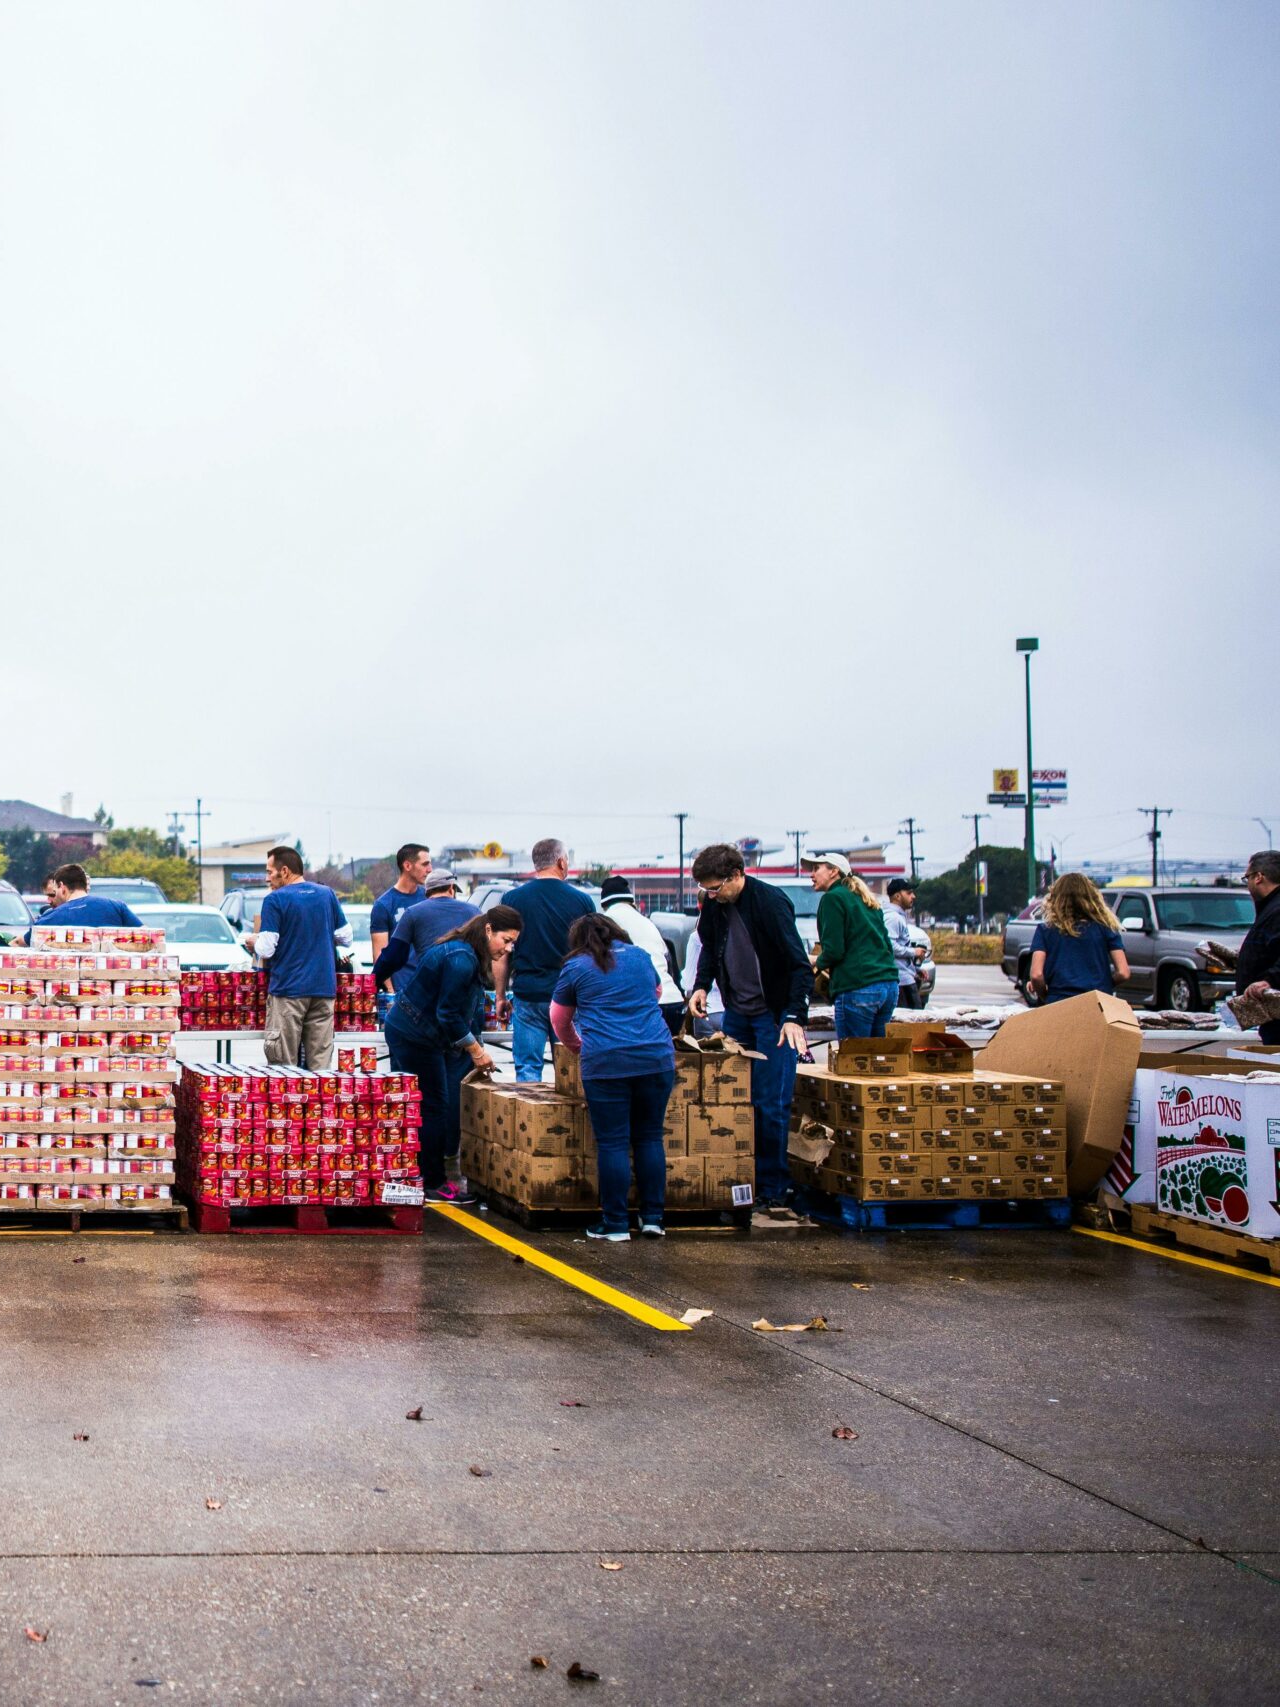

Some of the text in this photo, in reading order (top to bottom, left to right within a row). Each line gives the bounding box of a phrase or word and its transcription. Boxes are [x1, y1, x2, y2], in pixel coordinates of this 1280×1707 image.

[1032, 769, 1066, 781] EXXON
[1160, 1081, 1177, 1099] Fresh
[1158, 1095, 1242, 1127] WATERMELONS
